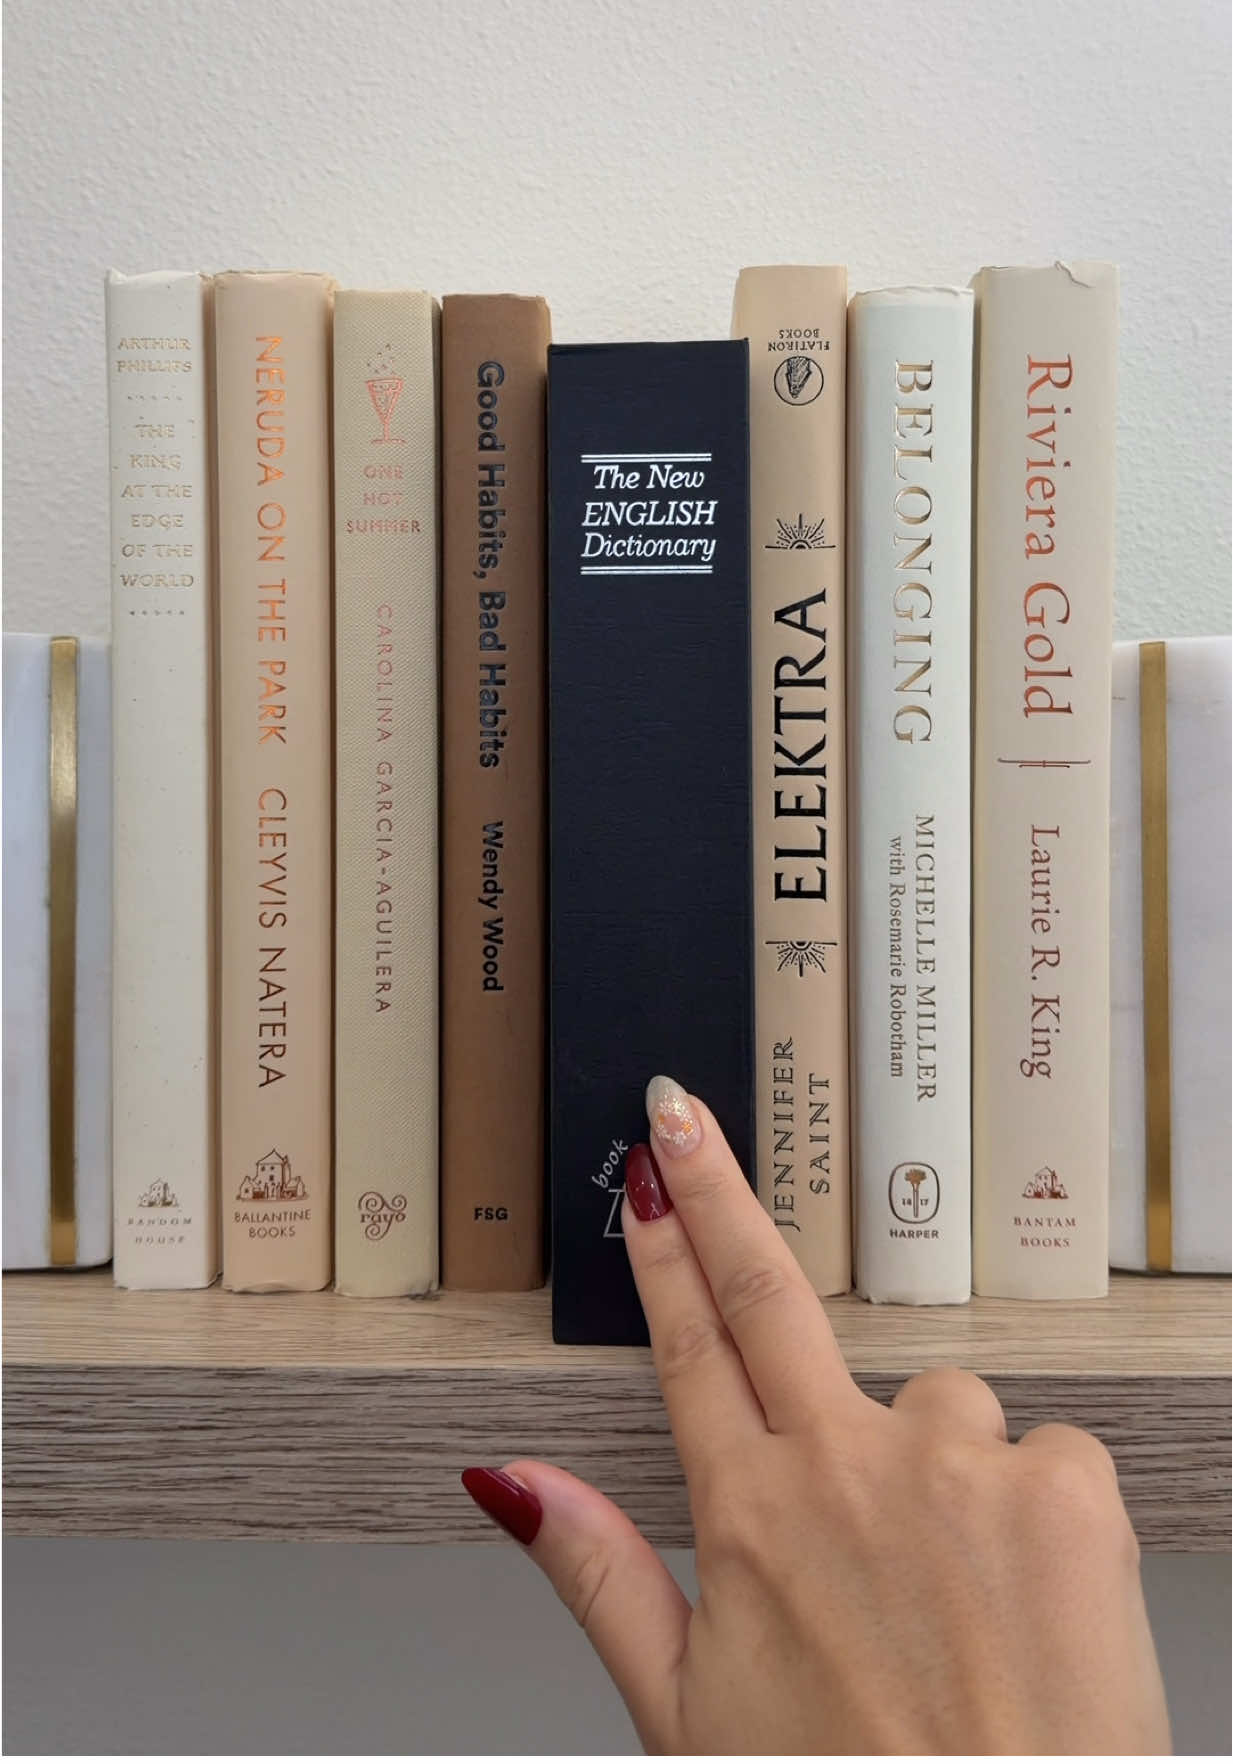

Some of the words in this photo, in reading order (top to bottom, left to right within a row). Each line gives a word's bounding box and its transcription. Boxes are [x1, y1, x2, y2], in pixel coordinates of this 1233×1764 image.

[117, 338, 192, 351] ARTHUR
[767, 340, 831, 353] FLATIRON
[779, 328, 820, 339] BOOKS
[116, 360, 193, 374] PHILLIPS
[135, 424, 176, 439] THE
[256, 335, 286, 486] NERUDA
[477, 361, 506, 452] Good
[130, 454, 182, 470] KING
[363, 465, 404, 479] ONE
[593, 464, 641, 489] The
[646, 464, 705, 489] New
[1025, 353, 1074, 560] Riviera
[120, 485, 147, 498] AT
[151, 485, 193, 498] THE
[130, 514, 185, 528] EDGE
[473, 463, 507, 580] Habits,
[581, 500, 719, 526] ENGLISH
[121, 544, 147, 557] OF
[152, 544, 193, 557] THE
[256, 502, 287, 562] ON
[345, 519, 421, 534] SUMMER
[580, 532, 717, 562] Dictionary
[893, 359, 934, 745] BELONGING
[119, 574, 195, 588] WORLD
[257, 578, 287, 642] THE
[478, 591, 507, 651] Bad
[1023, 582, 1074, 719] Gold
[257, 660, 287, 745] PARK
[375, 603, 394, 743] CAROLINA
[478, 663, 507, 768] Habits
[773, 587, 828, 903] ELEKTRA
[257, 788, 287, 929] CLEYVIS
[478, 821, 504, 910] Wendy
[889, 836, 906, 875] with
[1031, 824, 1061, 935] Laurie
[375, 761, 393, 1013] GARCIA-AGUILERA
[915, 815, 936, 975] MICHELLE
[482, 917, 504, 992] Wood
[889, 882, 906, 977] Rosemarie
[1031, 945, 1061, 982] R.
[258, 947, 287, 1088] NATERA
[890, 983, 907, 1077] Robotham
[916, 984, 937, 1102] MILLER
[1020, 994, 1061, 1080] King
[773, 1036, 801, 1231] JENNIFER
[808, 1072, 830, 1194] SAINT
[591, 1139, 629, 1189] book
[233, 1209, 311, 1225] BALLANTINE
[248, 1225, 296, 1239] BOOKS
[473, 1206, 509, 1222] FSG
[889, 1228, 940, 1240] HARPER
[1013, 1216, 1077, 1228] BANTAM
[1020, 1237, 1071, 1248] BOOKS
